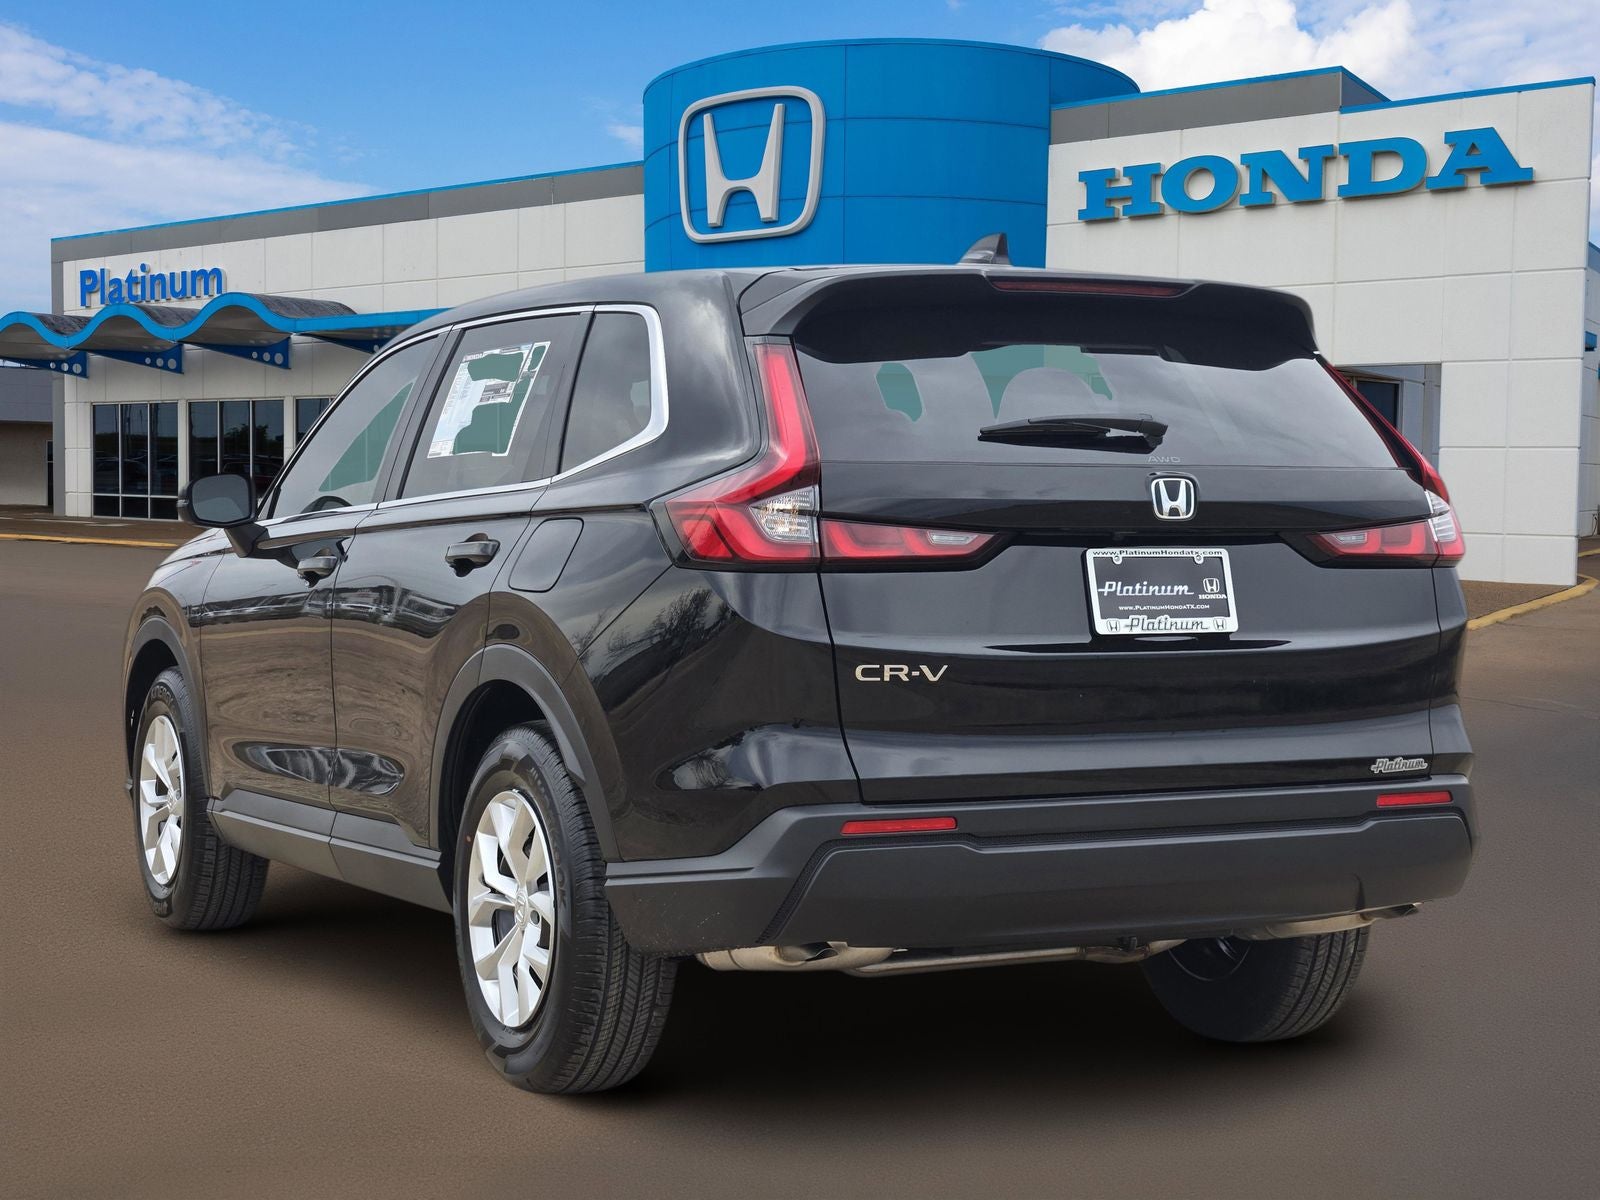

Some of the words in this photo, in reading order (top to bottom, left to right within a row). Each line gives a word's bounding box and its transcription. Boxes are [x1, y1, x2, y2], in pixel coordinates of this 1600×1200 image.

[1077, 126, 1534, 221] HONDA
[79, 262, 228, 308] Platinum
[1097, 581, 1195, 596] Platinum
[1123, 615, 1210, 632] Platinum
[855, 664, 949, 682] CR-V
[1370, 757, 1428, 774] Platinum
